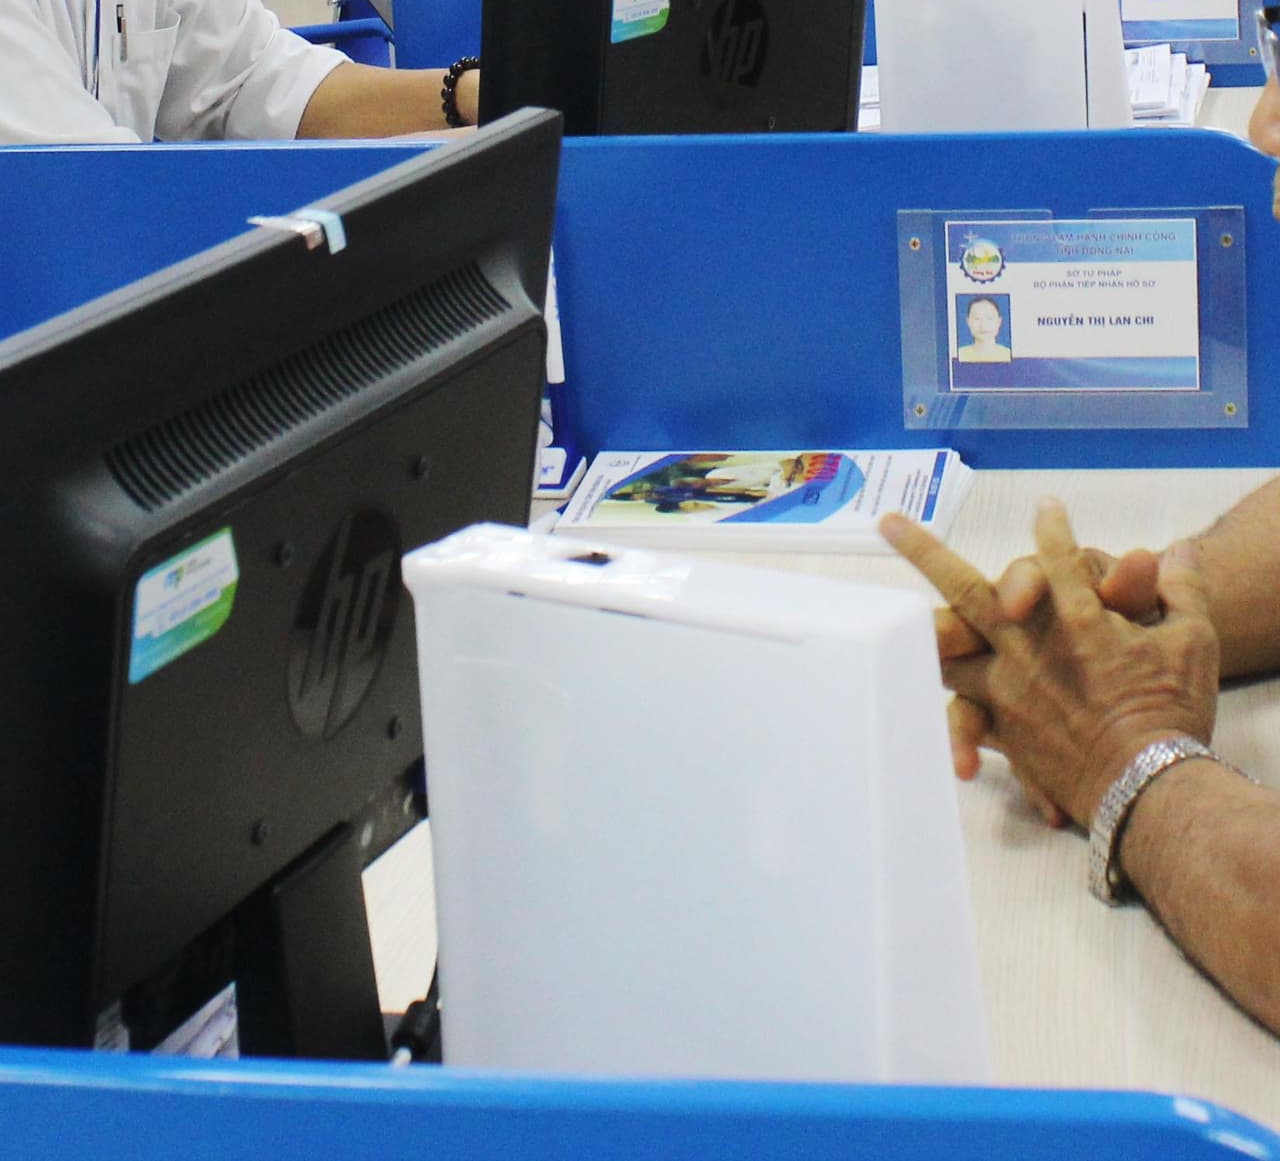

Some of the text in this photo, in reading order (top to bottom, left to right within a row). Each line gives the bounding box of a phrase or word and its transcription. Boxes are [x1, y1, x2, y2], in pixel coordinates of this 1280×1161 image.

[1037, 314, 1154, 328] NGUYỄN THỊ LAN CHI
[287, 508, 400, 740] hp
